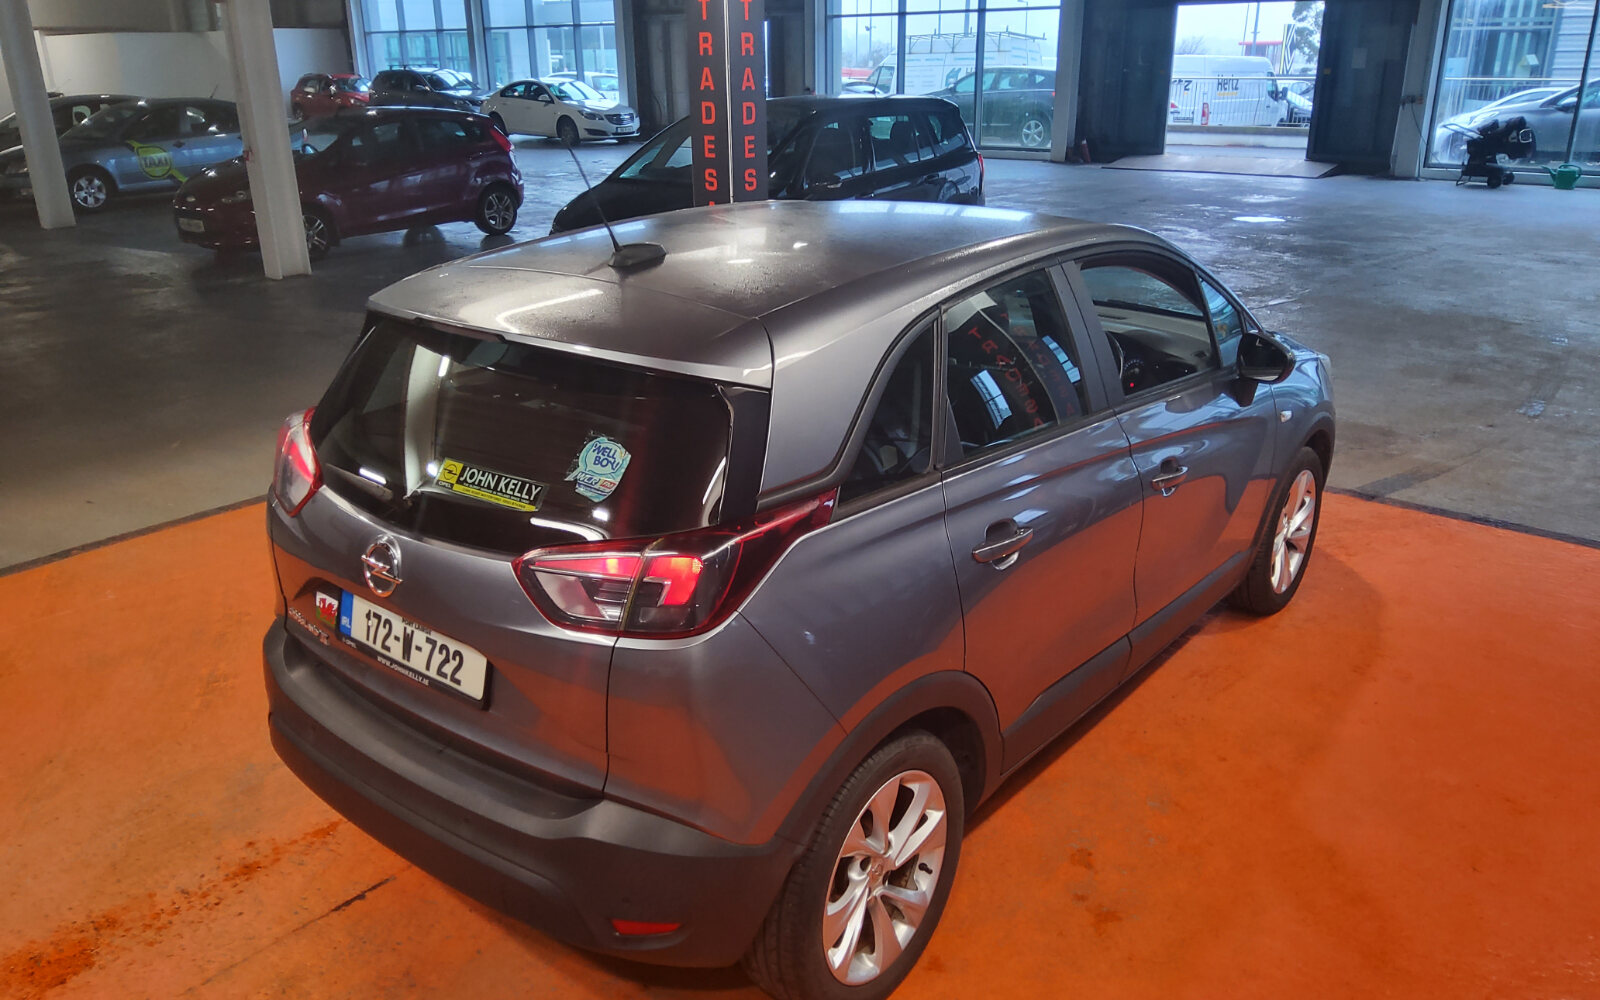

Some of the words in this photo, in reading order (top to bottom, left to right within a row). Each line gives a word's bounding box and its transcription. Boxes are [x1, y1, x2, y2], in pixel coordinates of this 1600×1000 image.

[740, 0, 758, 192] TRADES
[1217, 74, 1239, 91] Hertz
[698, 0, 718, 206] TRADES
[142, 154, 169, 168] TAXI
[438, 481, 452, 489] OPEL
[460, 467, 498, 489] JOHN
[498, 477, 541, 501] KELLY
[365, 609, 464, 686] 172-W-722
